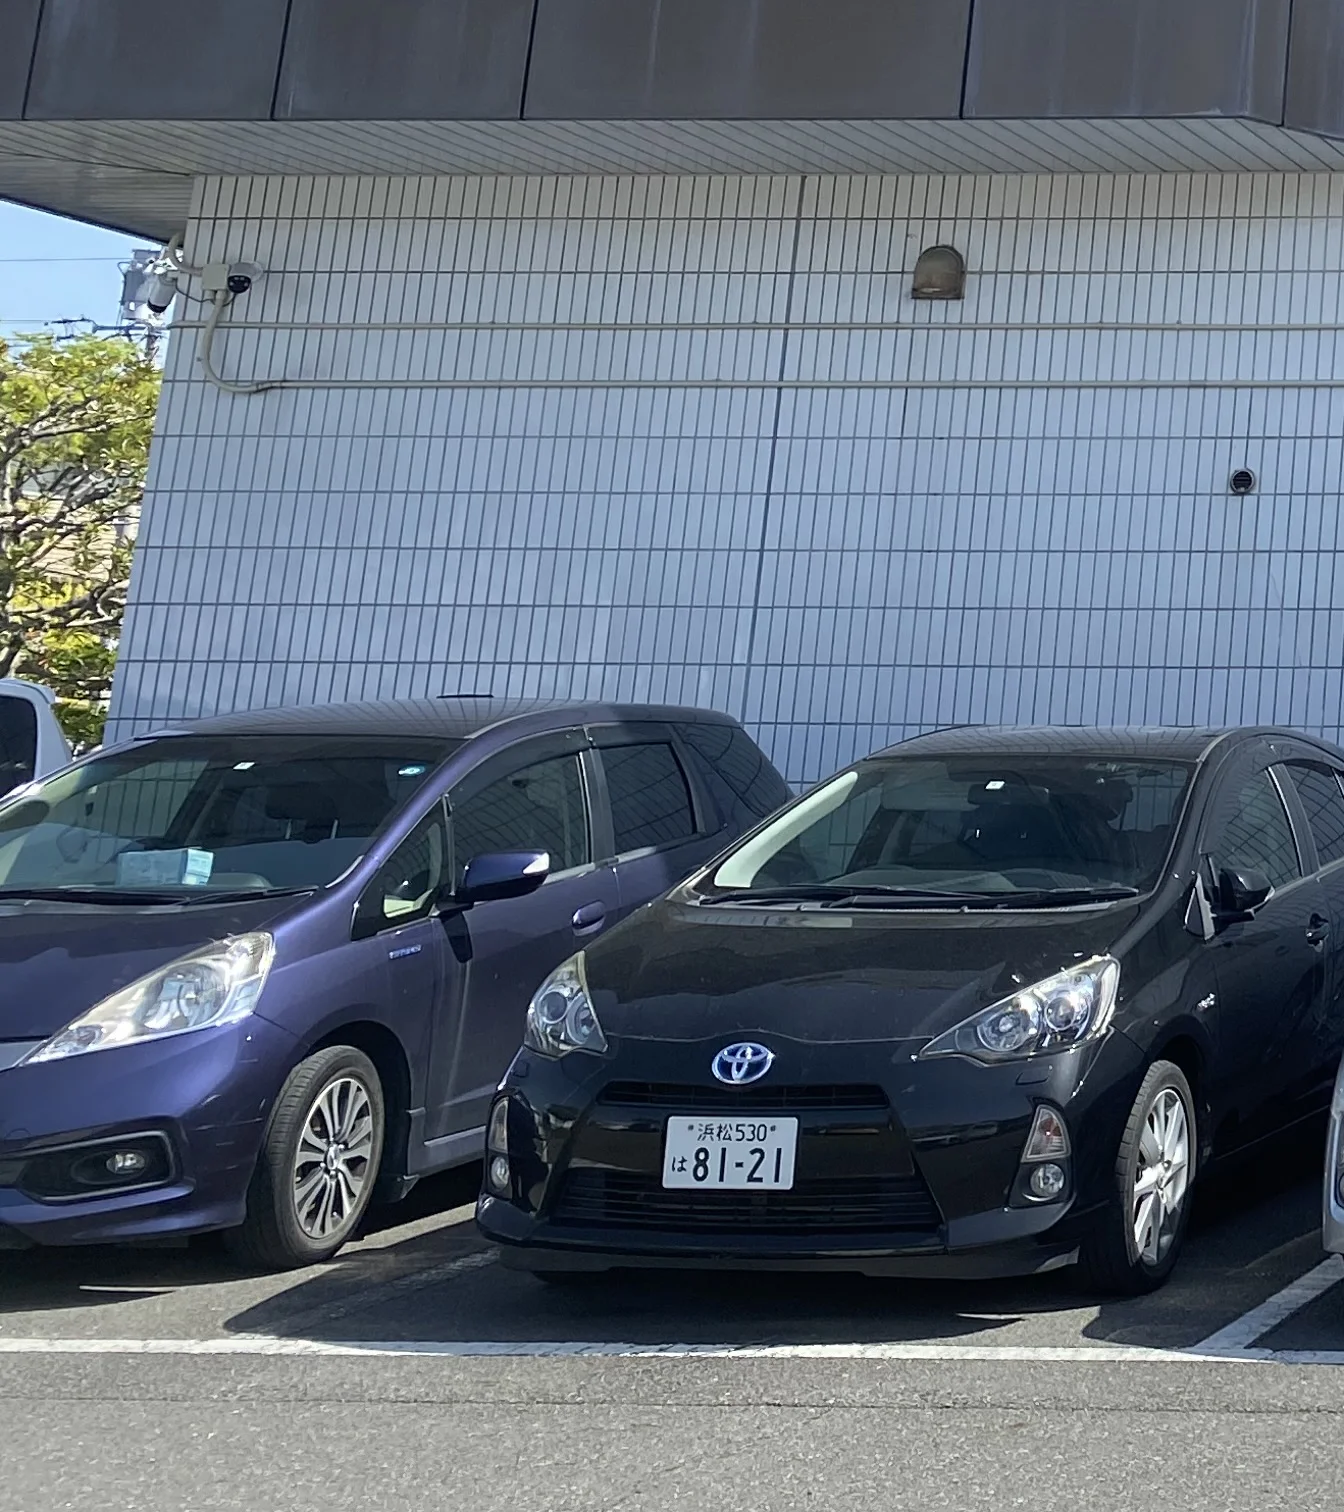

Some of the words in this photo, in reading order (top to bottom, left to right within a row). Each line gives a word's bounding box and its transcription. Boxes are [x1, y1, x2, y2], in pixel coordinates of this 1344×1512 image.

[697, 1123, 767, 1142] 浜松530
[671, 1156, 688, 1172] は
[692, 1147, 783, 1183] 81-21
